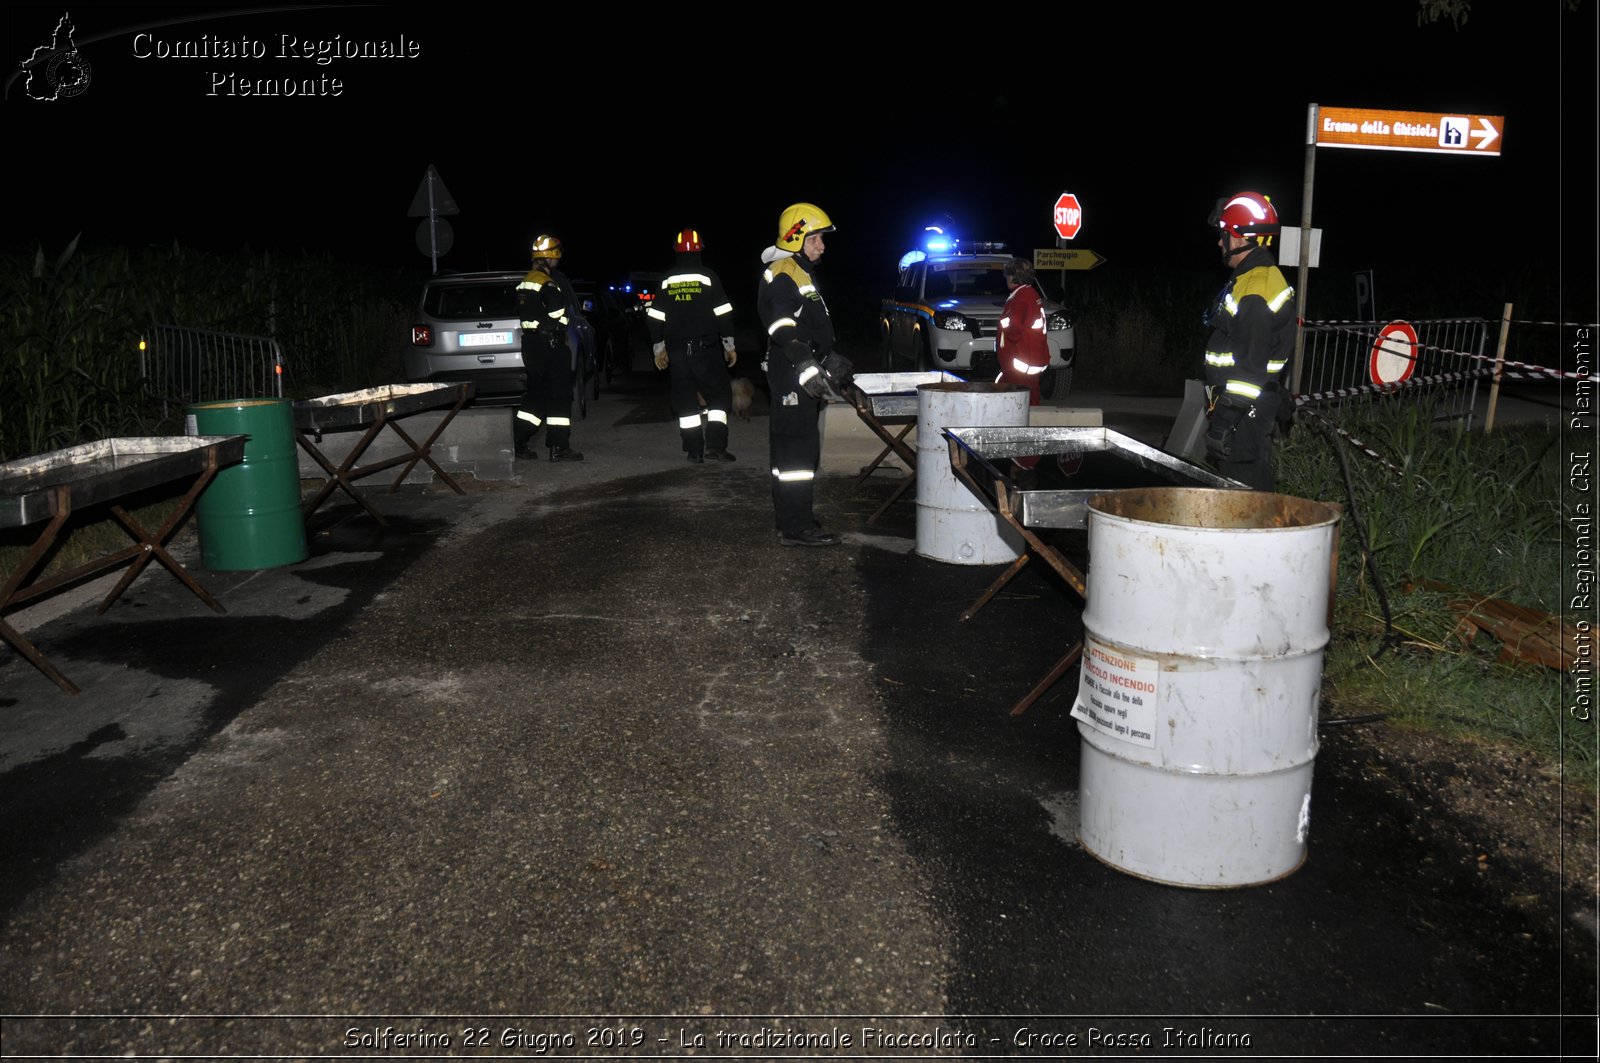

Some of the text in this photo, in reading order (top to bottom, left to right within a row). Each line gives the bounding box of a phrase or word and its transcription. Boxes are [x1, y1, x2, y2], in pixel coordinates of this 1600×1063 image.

[1323, 118, 1438, 137] Eremo della Ghisiola
[1055, 206, 1080, 226] STOP
[1036, 251, 1078, 259] Parcheggio
[1036, 259, 1065, 268] Parking
[1091, 647, 1137, 672] ATTENZIONE
[1109, 673, 1155, 694] INCENDIO
[1130, 727, 1151, 741] percorso
